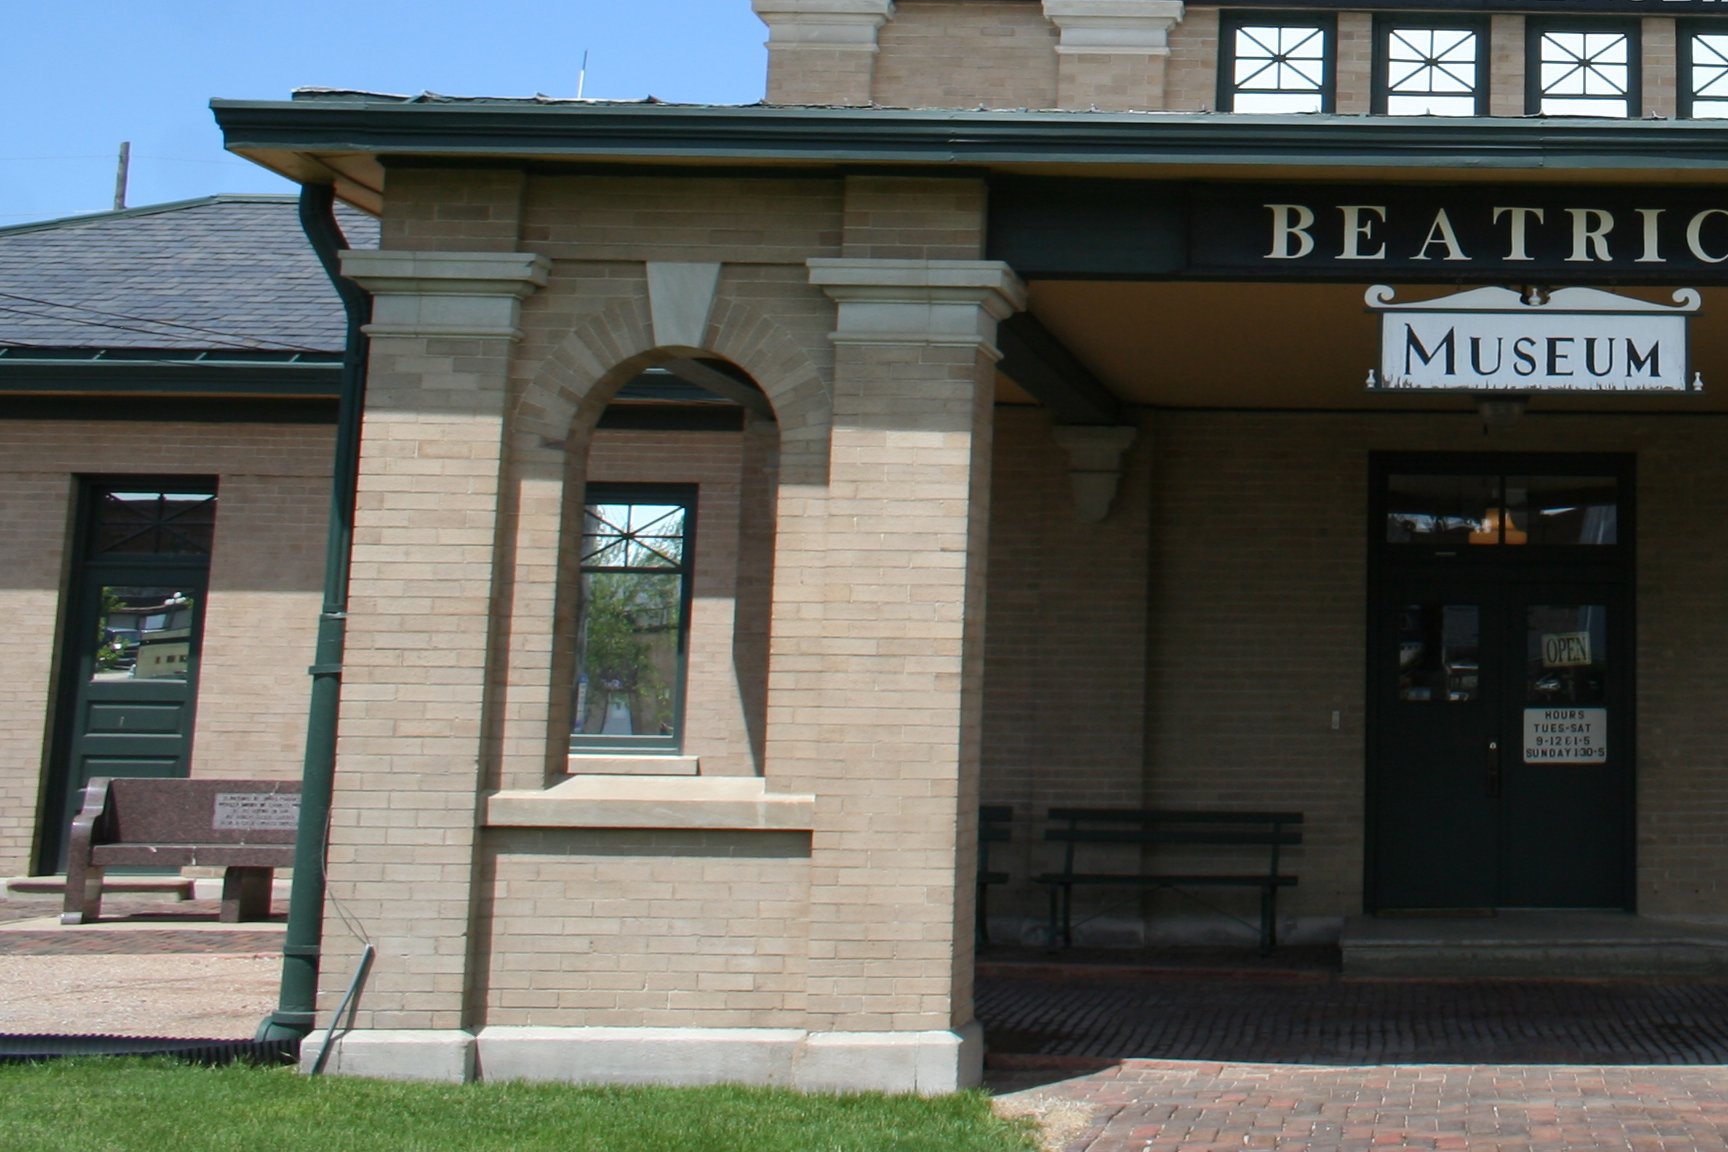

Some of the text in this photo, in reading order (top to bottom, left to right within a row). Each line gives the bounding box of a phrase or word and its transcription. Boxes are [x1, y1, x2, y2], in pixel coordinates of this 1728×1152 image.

[1404, 322, 1661, 378] MUSEUM
[1546, 636, 1587, 664] OPEN
[1545, 710, 1585, 720] HOURS
[1534, 723, 1592, 733] TUES-SAT
[1526, 748, 1572, 758] SUNDAY
